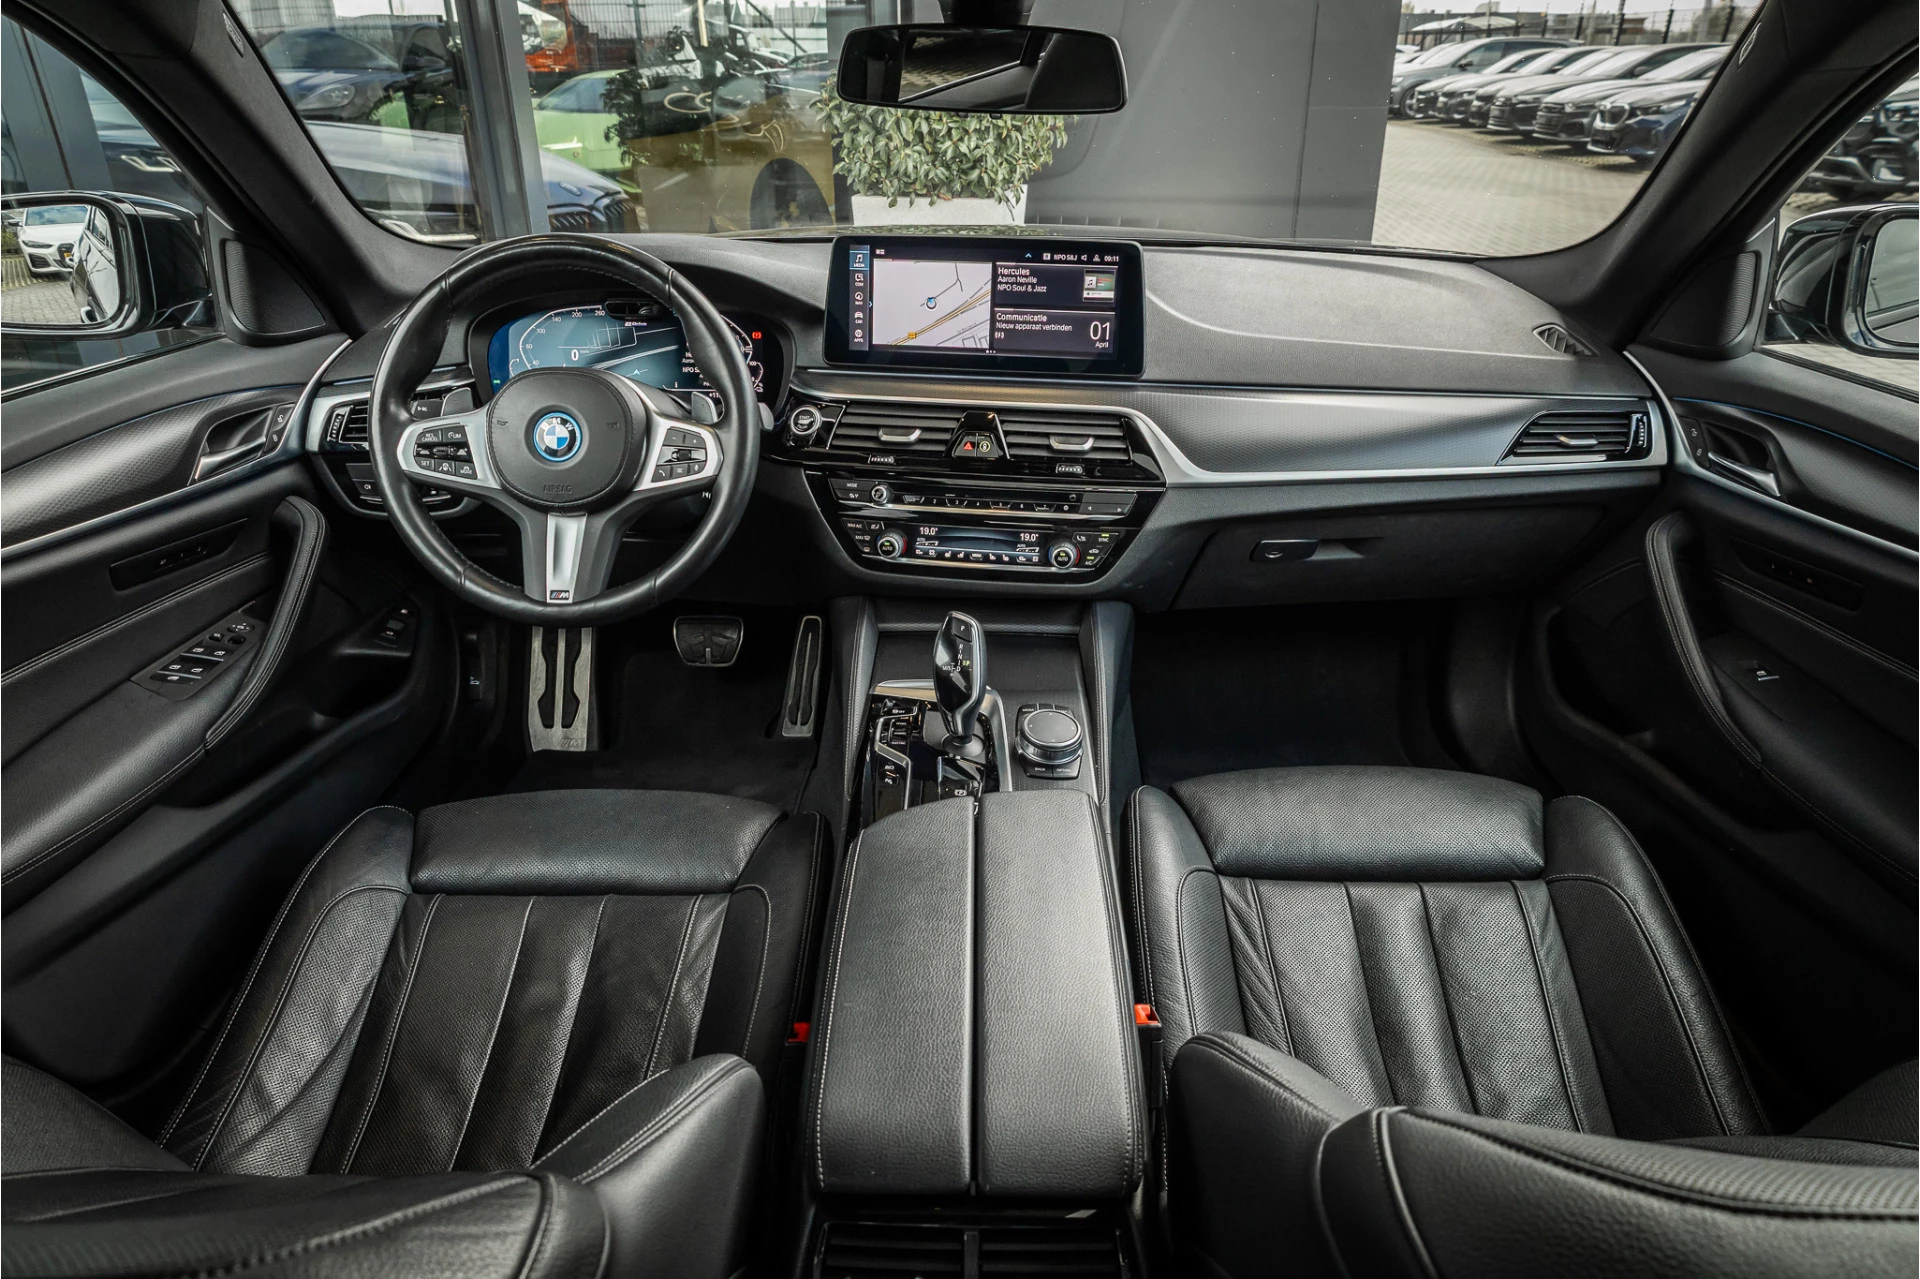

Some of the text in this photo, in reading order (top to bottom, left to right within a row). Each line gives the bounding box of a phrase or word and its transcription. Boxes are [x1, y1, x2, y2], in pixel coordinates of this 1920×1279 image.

[998, 267, 1030, 276] Hercules
[1033, 285, 1047, 293] Jazz
[996, 312, 1047, 322] Communicatie
[1015, 323, 1042, 331] apparaat
[1042, 324, 1072, 332] verbinden
[1090, 321, 1111, 340] 01
[1095, 341, 1109, 349] April
[571, 349, 579, 361] 0
[541, 417, 574, 431] BMW
[543, 484, 573, 494] AIRBAG
